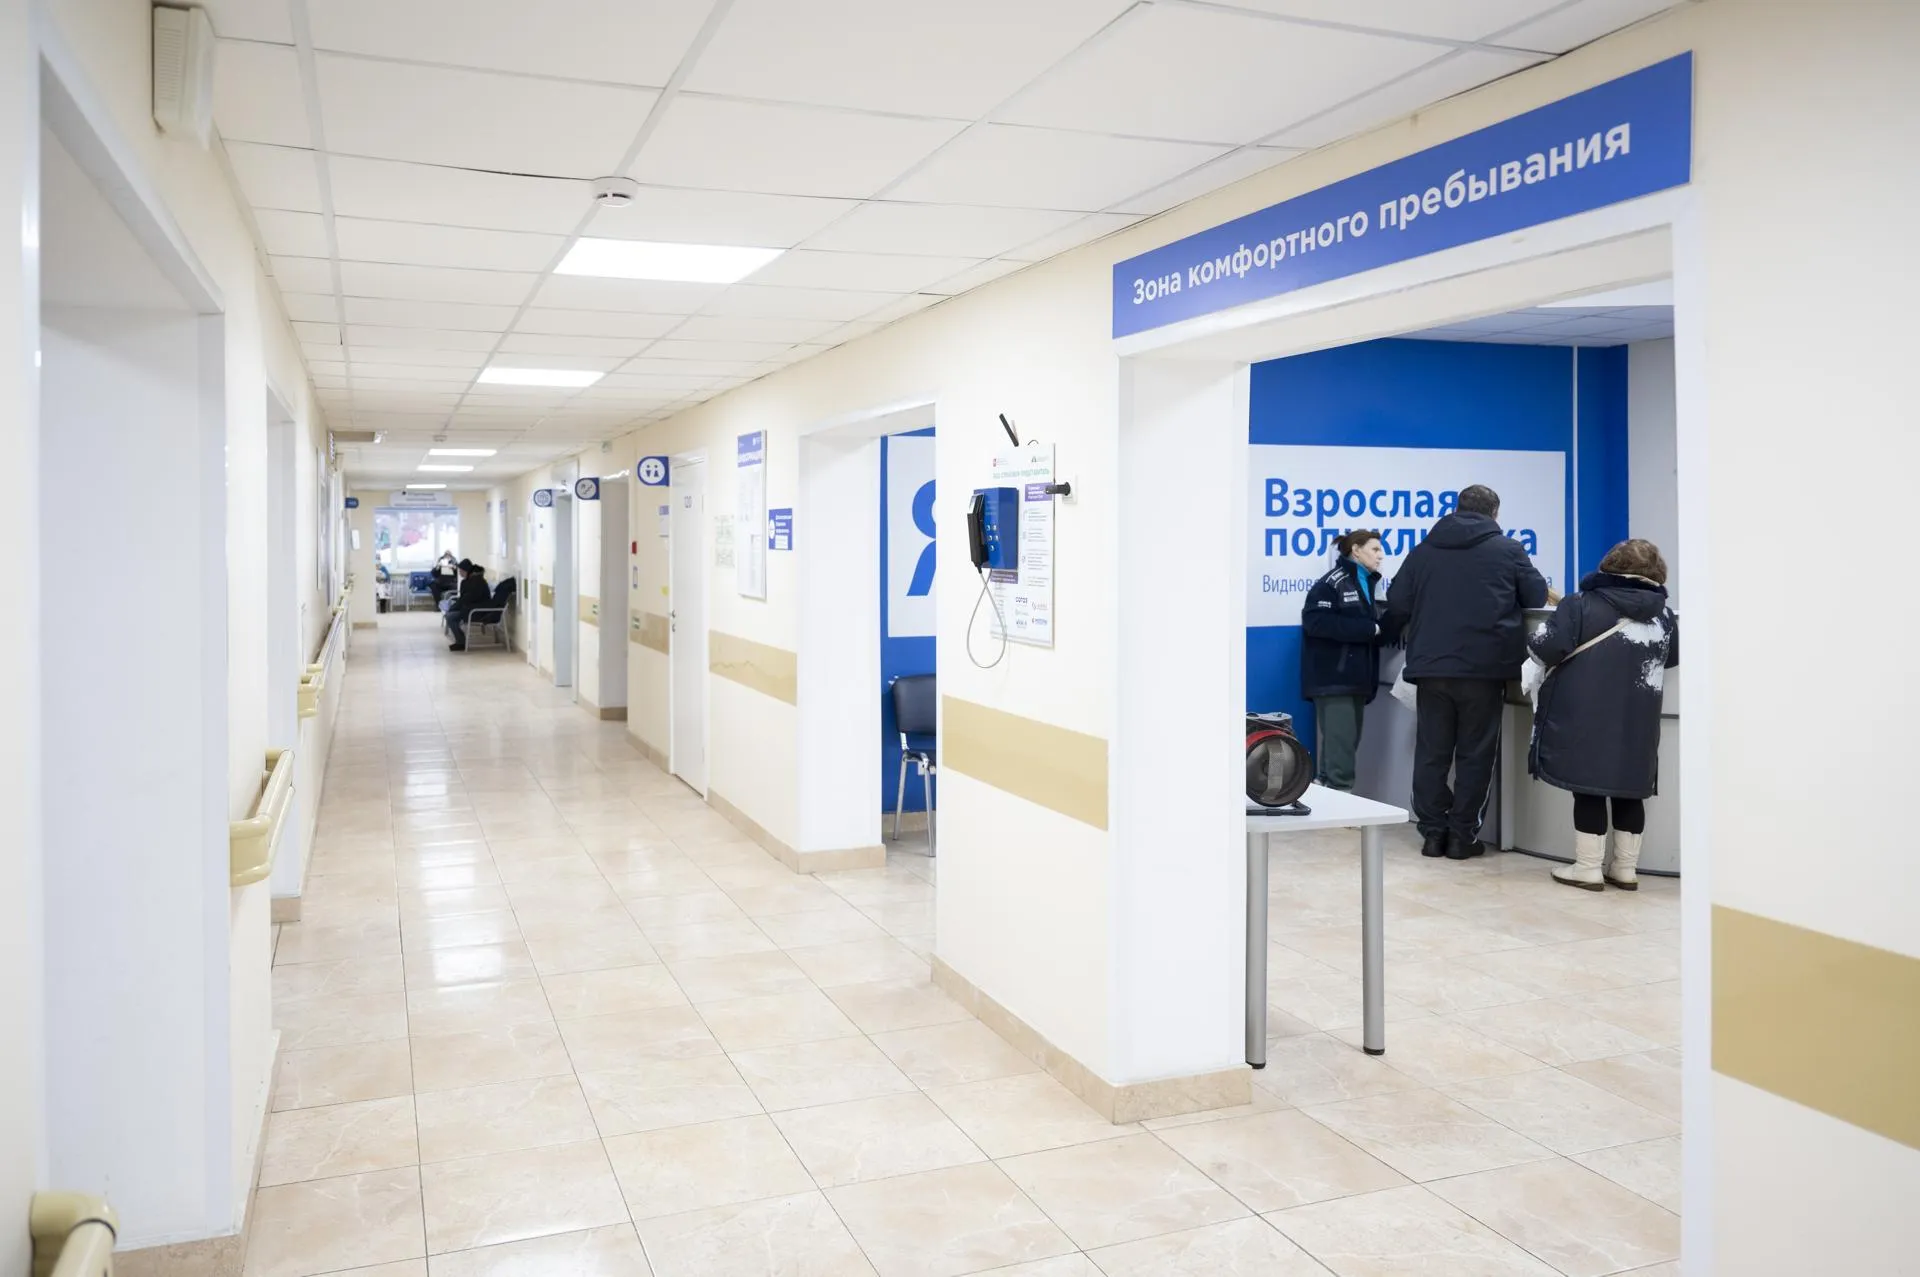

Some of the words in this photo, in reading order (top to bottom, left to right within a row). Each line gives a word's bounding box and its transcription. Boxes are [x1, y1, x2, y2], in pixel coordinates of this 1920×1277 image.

[1131, 271, 1183, 306] Зона
[1188, 210, 1369, 290] комфортного
[1379, 123, 1630, 231] пребывания
[1264, 477, 1461, 528] Взрослая
